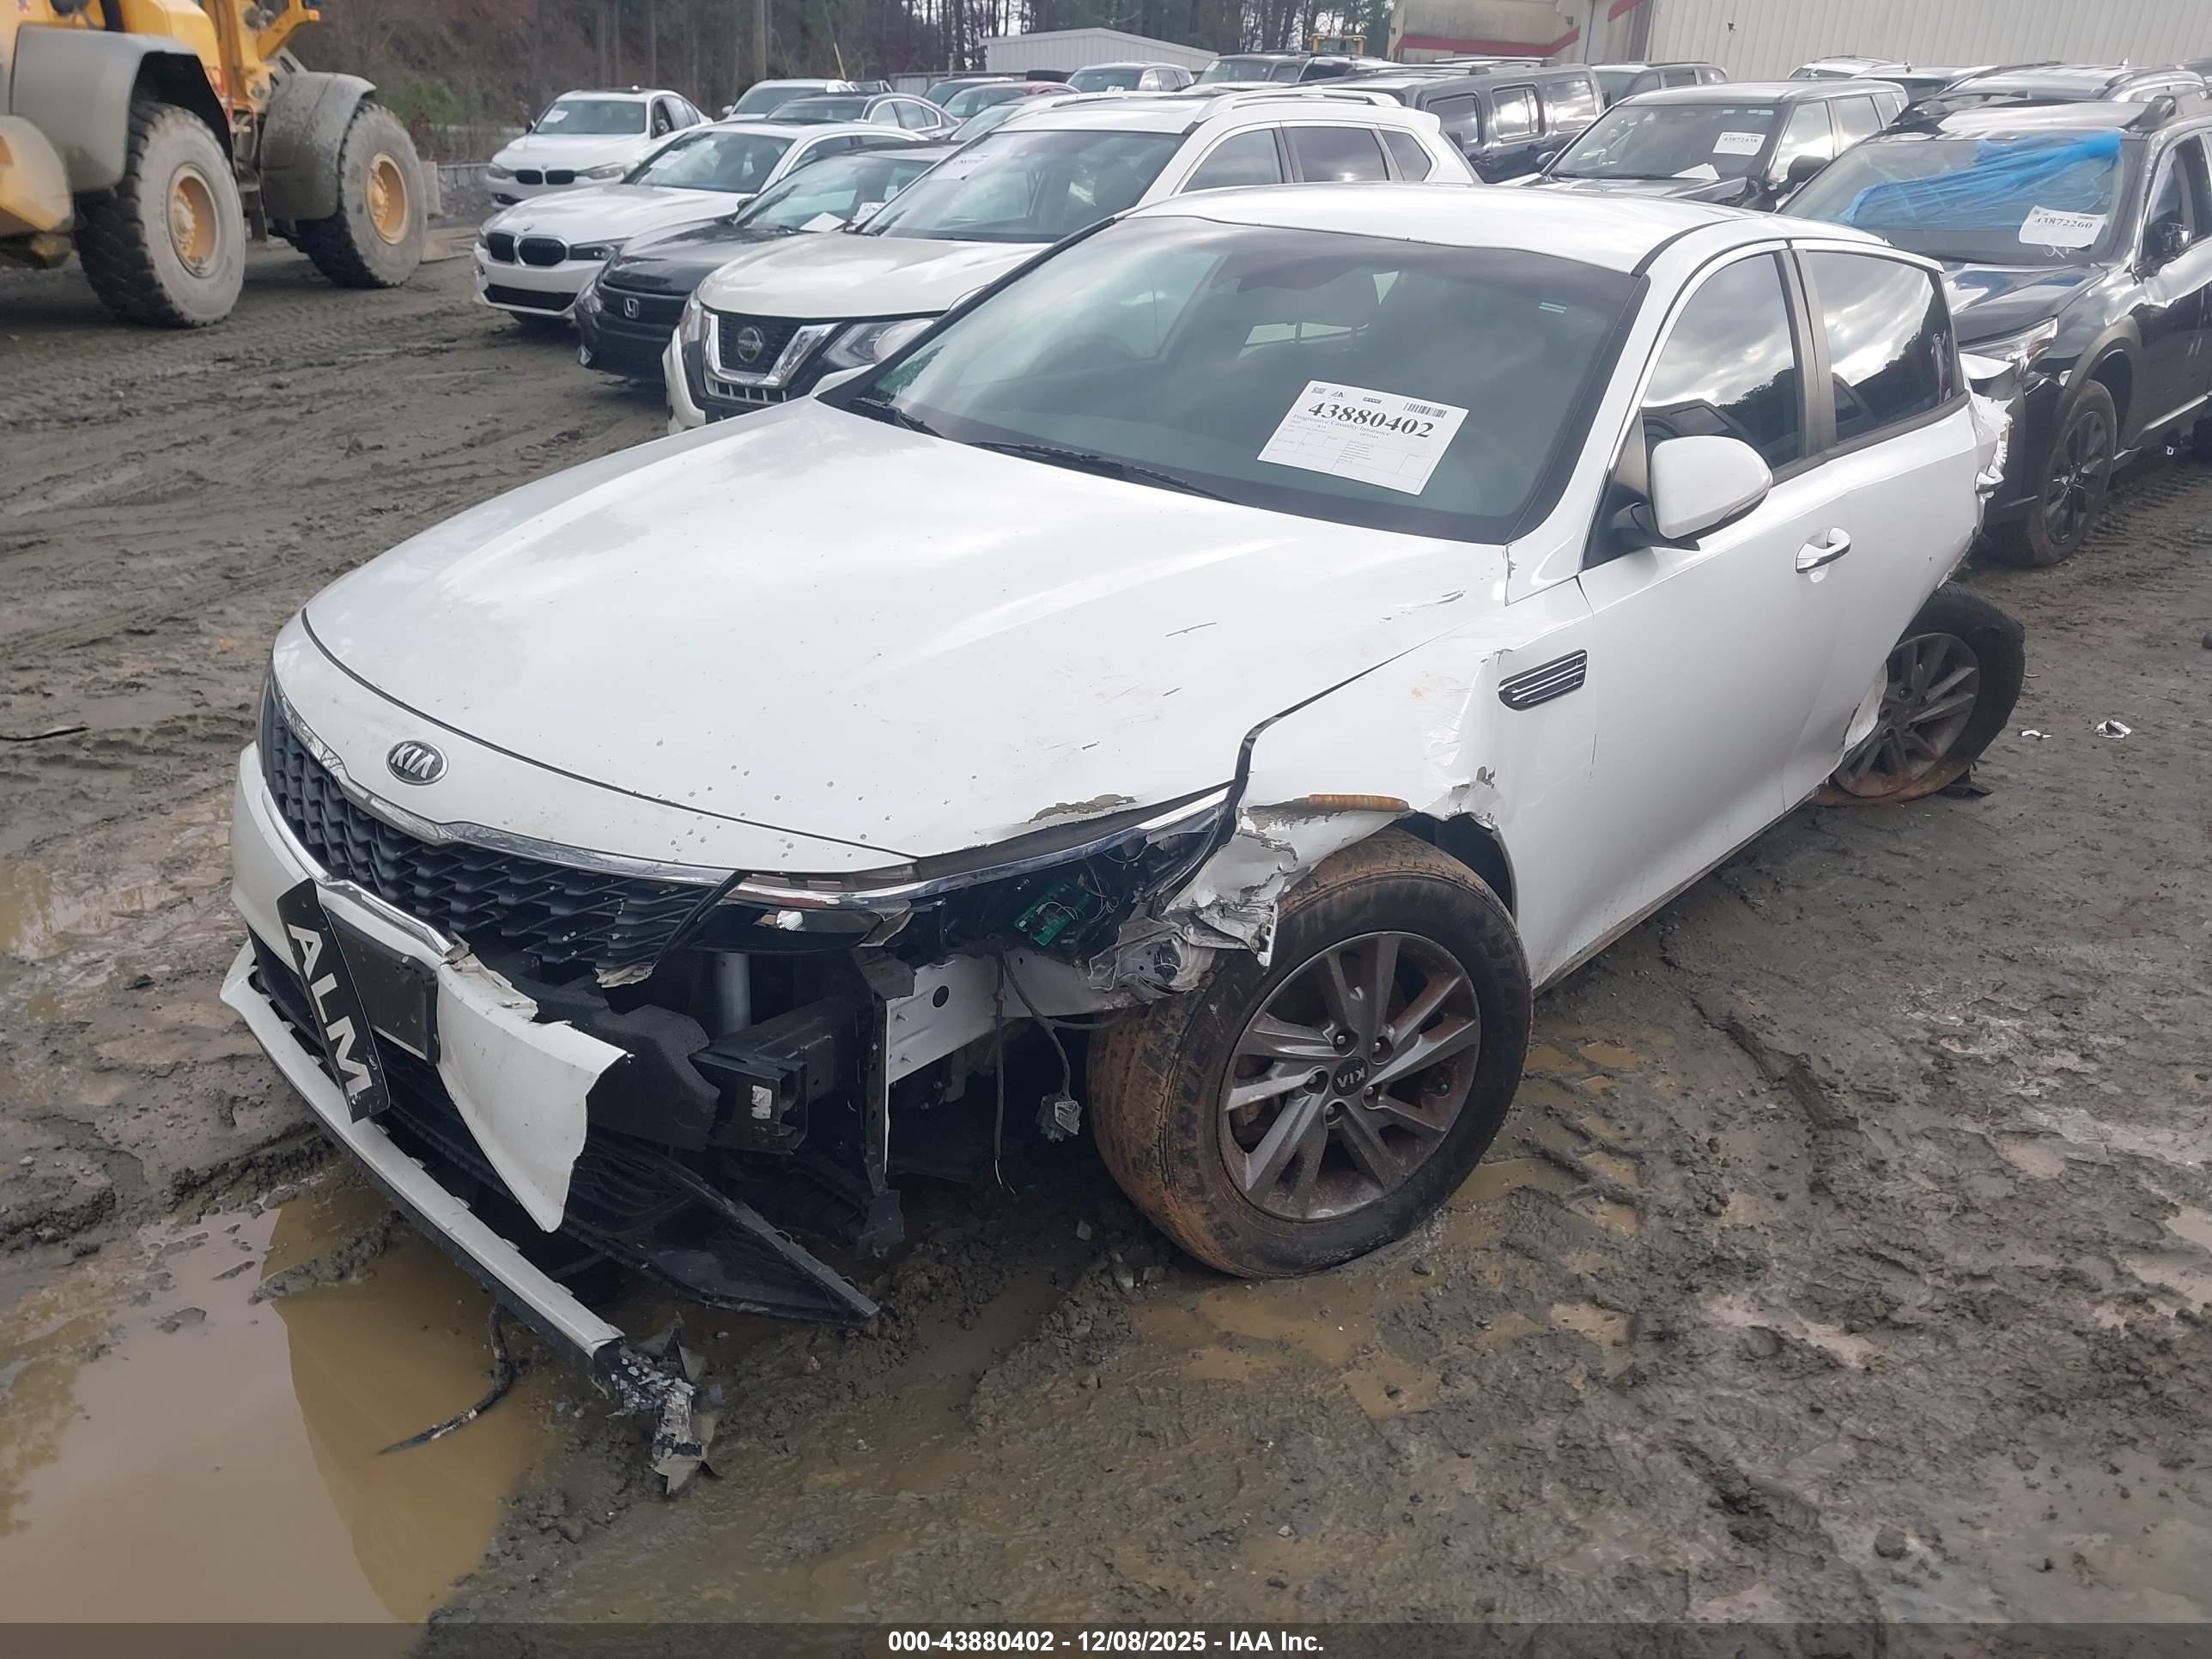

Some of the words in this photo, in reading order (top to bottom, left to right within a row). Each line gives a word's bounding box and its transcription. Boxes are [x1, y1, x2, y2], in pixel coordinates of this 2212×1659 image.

[1293, 414, 1329, 424] Progressive
[1330, 419, 1358, 430] Casualty
[1359, 425, 1391, 436] Insurance
[1308, 402, 1434, 438] 43880402
[390, 743, 435, 779] KIA
[288, 923, 380, 1097] ALM
[1336, 1066, 1365, 1088] KIA
